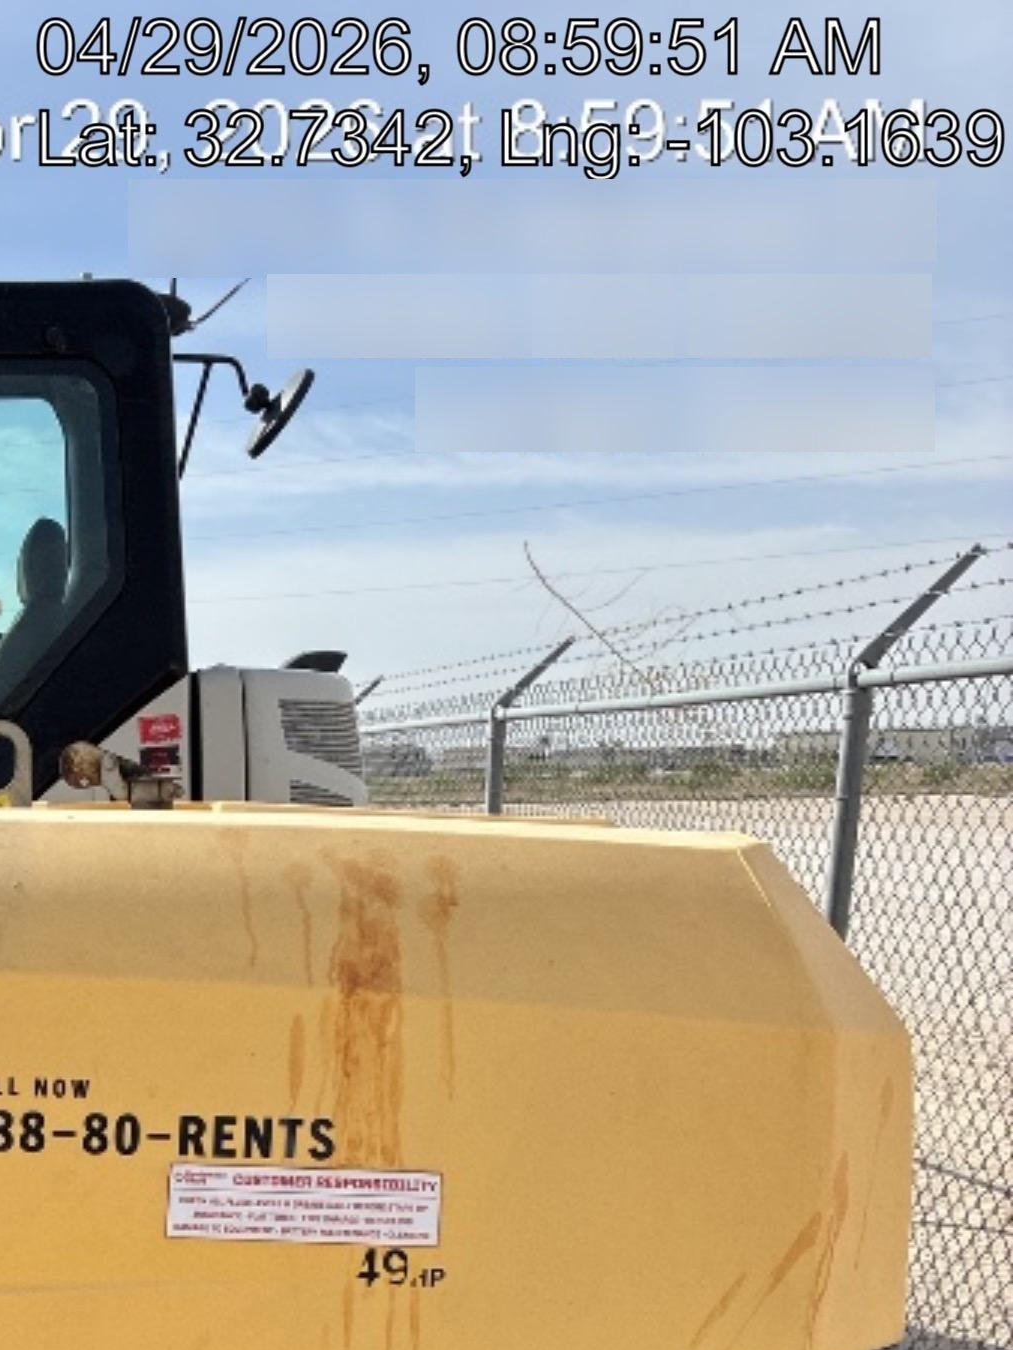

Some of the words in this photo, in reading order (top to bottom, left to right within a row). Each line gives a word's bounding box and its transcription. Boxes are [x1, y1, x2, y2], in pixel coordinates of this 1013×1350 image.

[34, 1079, 90, 1099] NOW
[232, 1173, 313, 1189] CUSTOMER
[316, 1175, 438, 1192] RESPONSIBILITY
